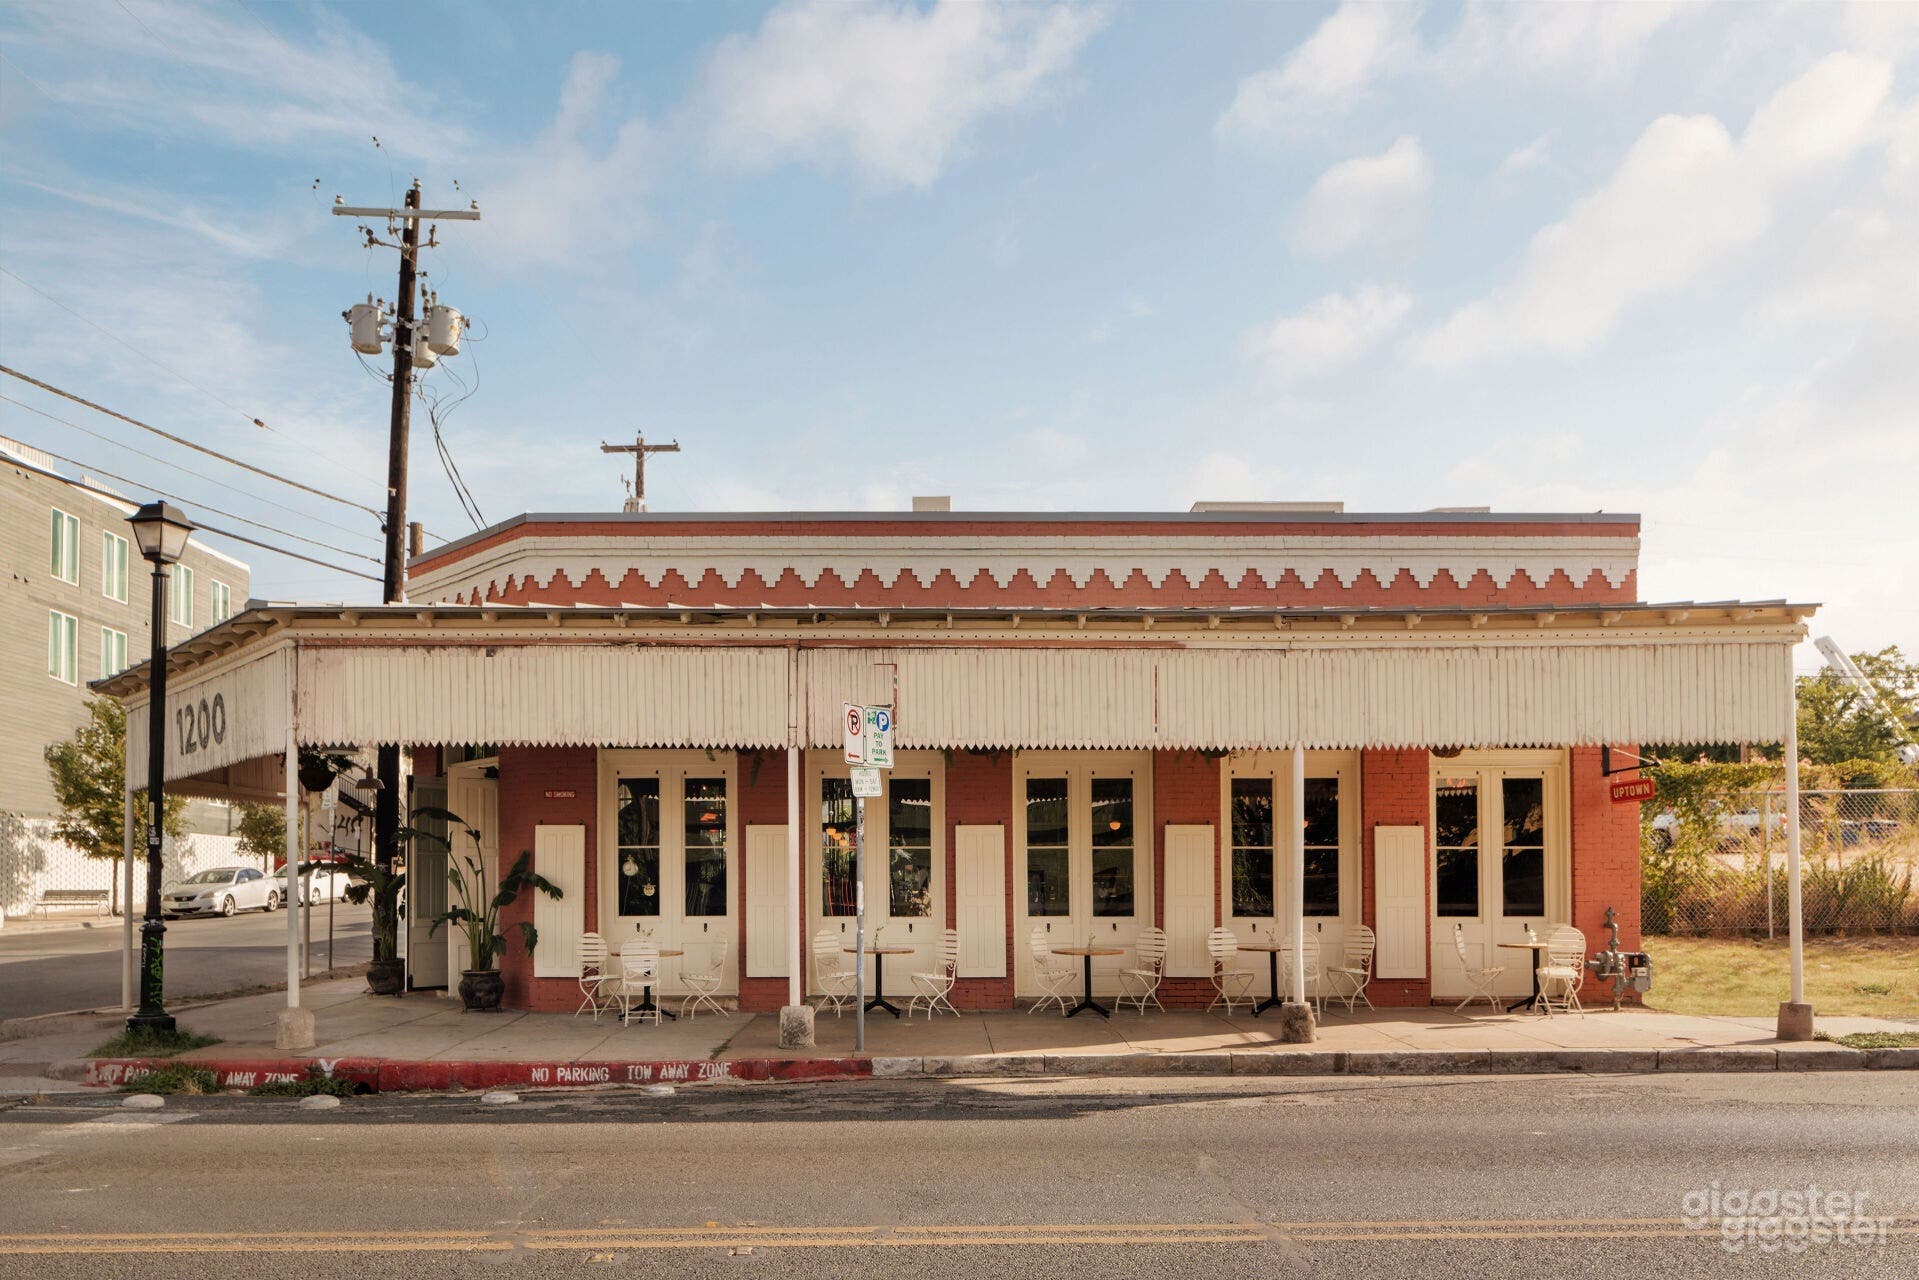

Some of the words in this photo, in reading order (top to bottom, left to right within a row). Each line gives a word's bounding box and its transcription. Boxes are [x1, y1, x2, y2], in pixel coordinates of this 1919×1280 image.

[177, 692, 225, 756] 1200
[875, 740, 882, 748] TO
[872, 748, 887, 756] PARK
[1613, 783, 1650, 798] UPTOWN
[225, 1071, 256, 1087] AWAY
[532, 1068, 549, 1082] NO
[557, 1067, 610, 1082] PARKING
[627, 1065, 652, 1080] TOW
[660, 1063, 690, 1079] AWAY
[698, 1062, 732, 1078] ZONE
